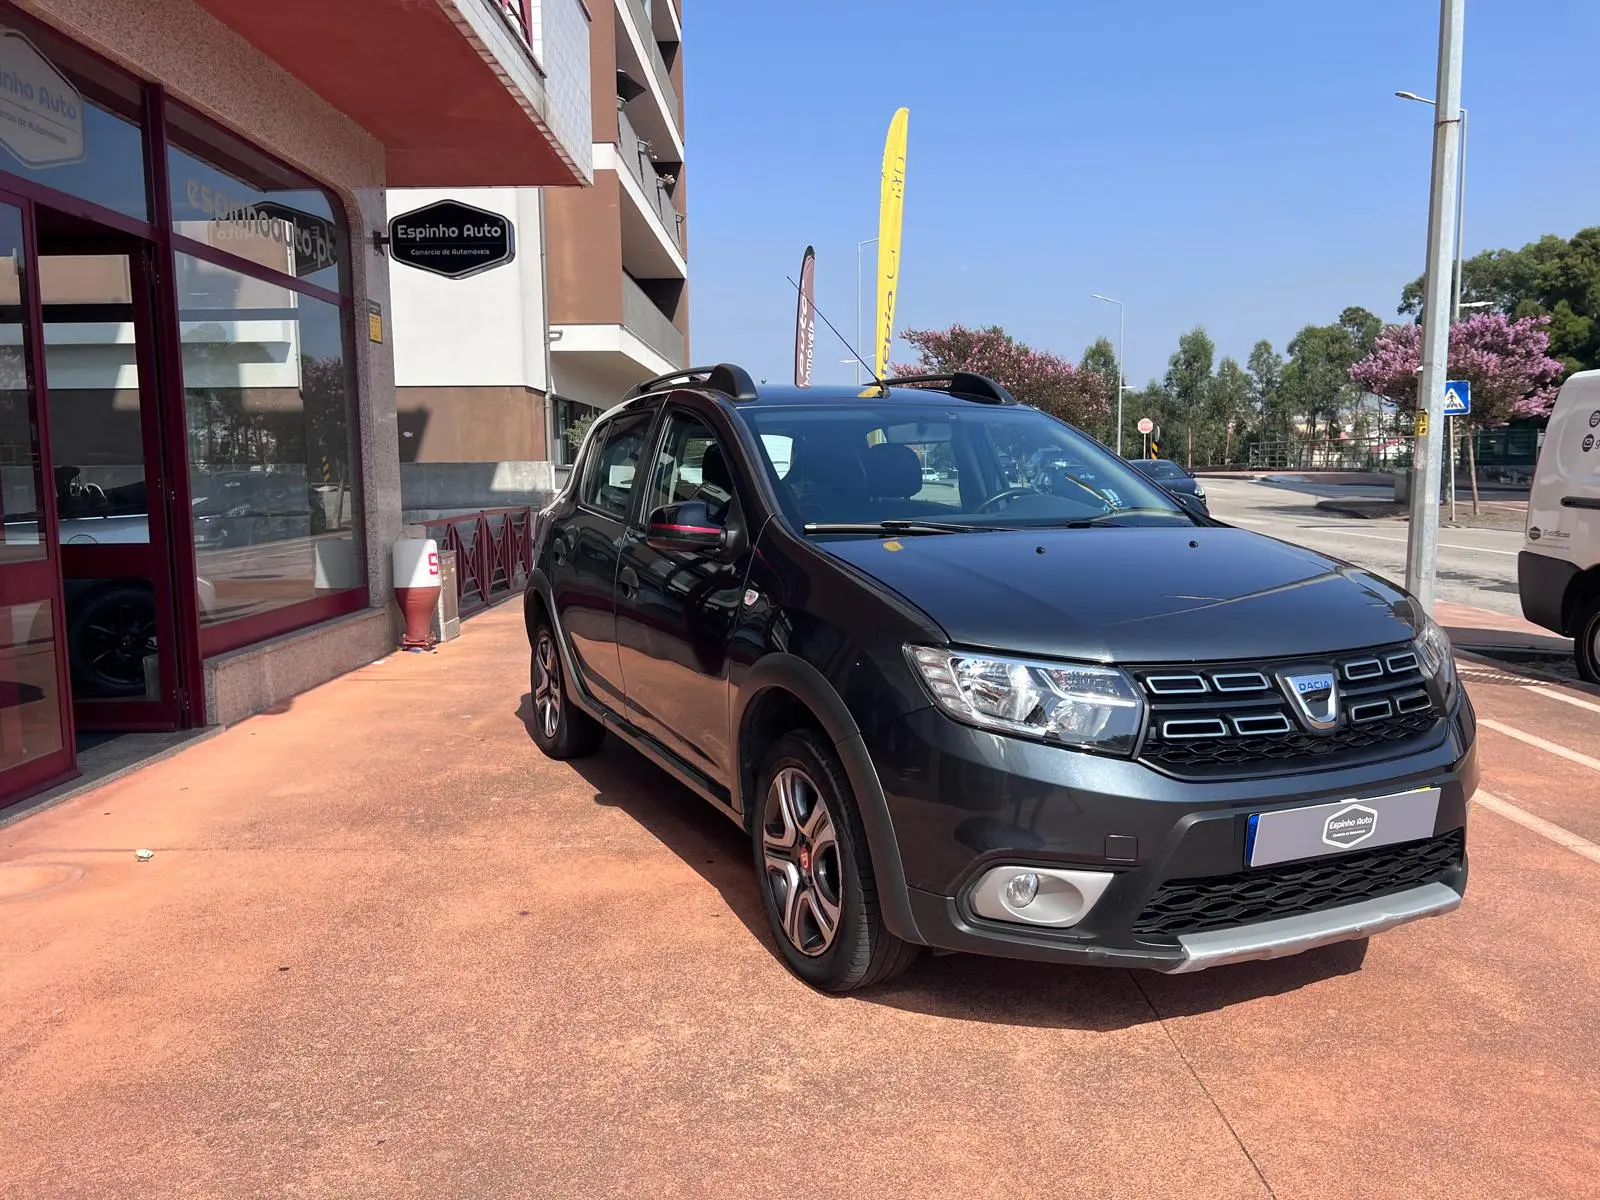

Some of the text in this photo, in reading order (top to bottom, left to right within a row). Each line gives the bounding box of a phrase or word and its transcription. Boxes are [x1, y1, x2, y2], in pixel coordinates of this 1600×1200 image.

[40, 86, 77, 119] Auto
[397, 223, 502, 242] Espinho Auto
[1298, 680, 1331, 691] DACIA
